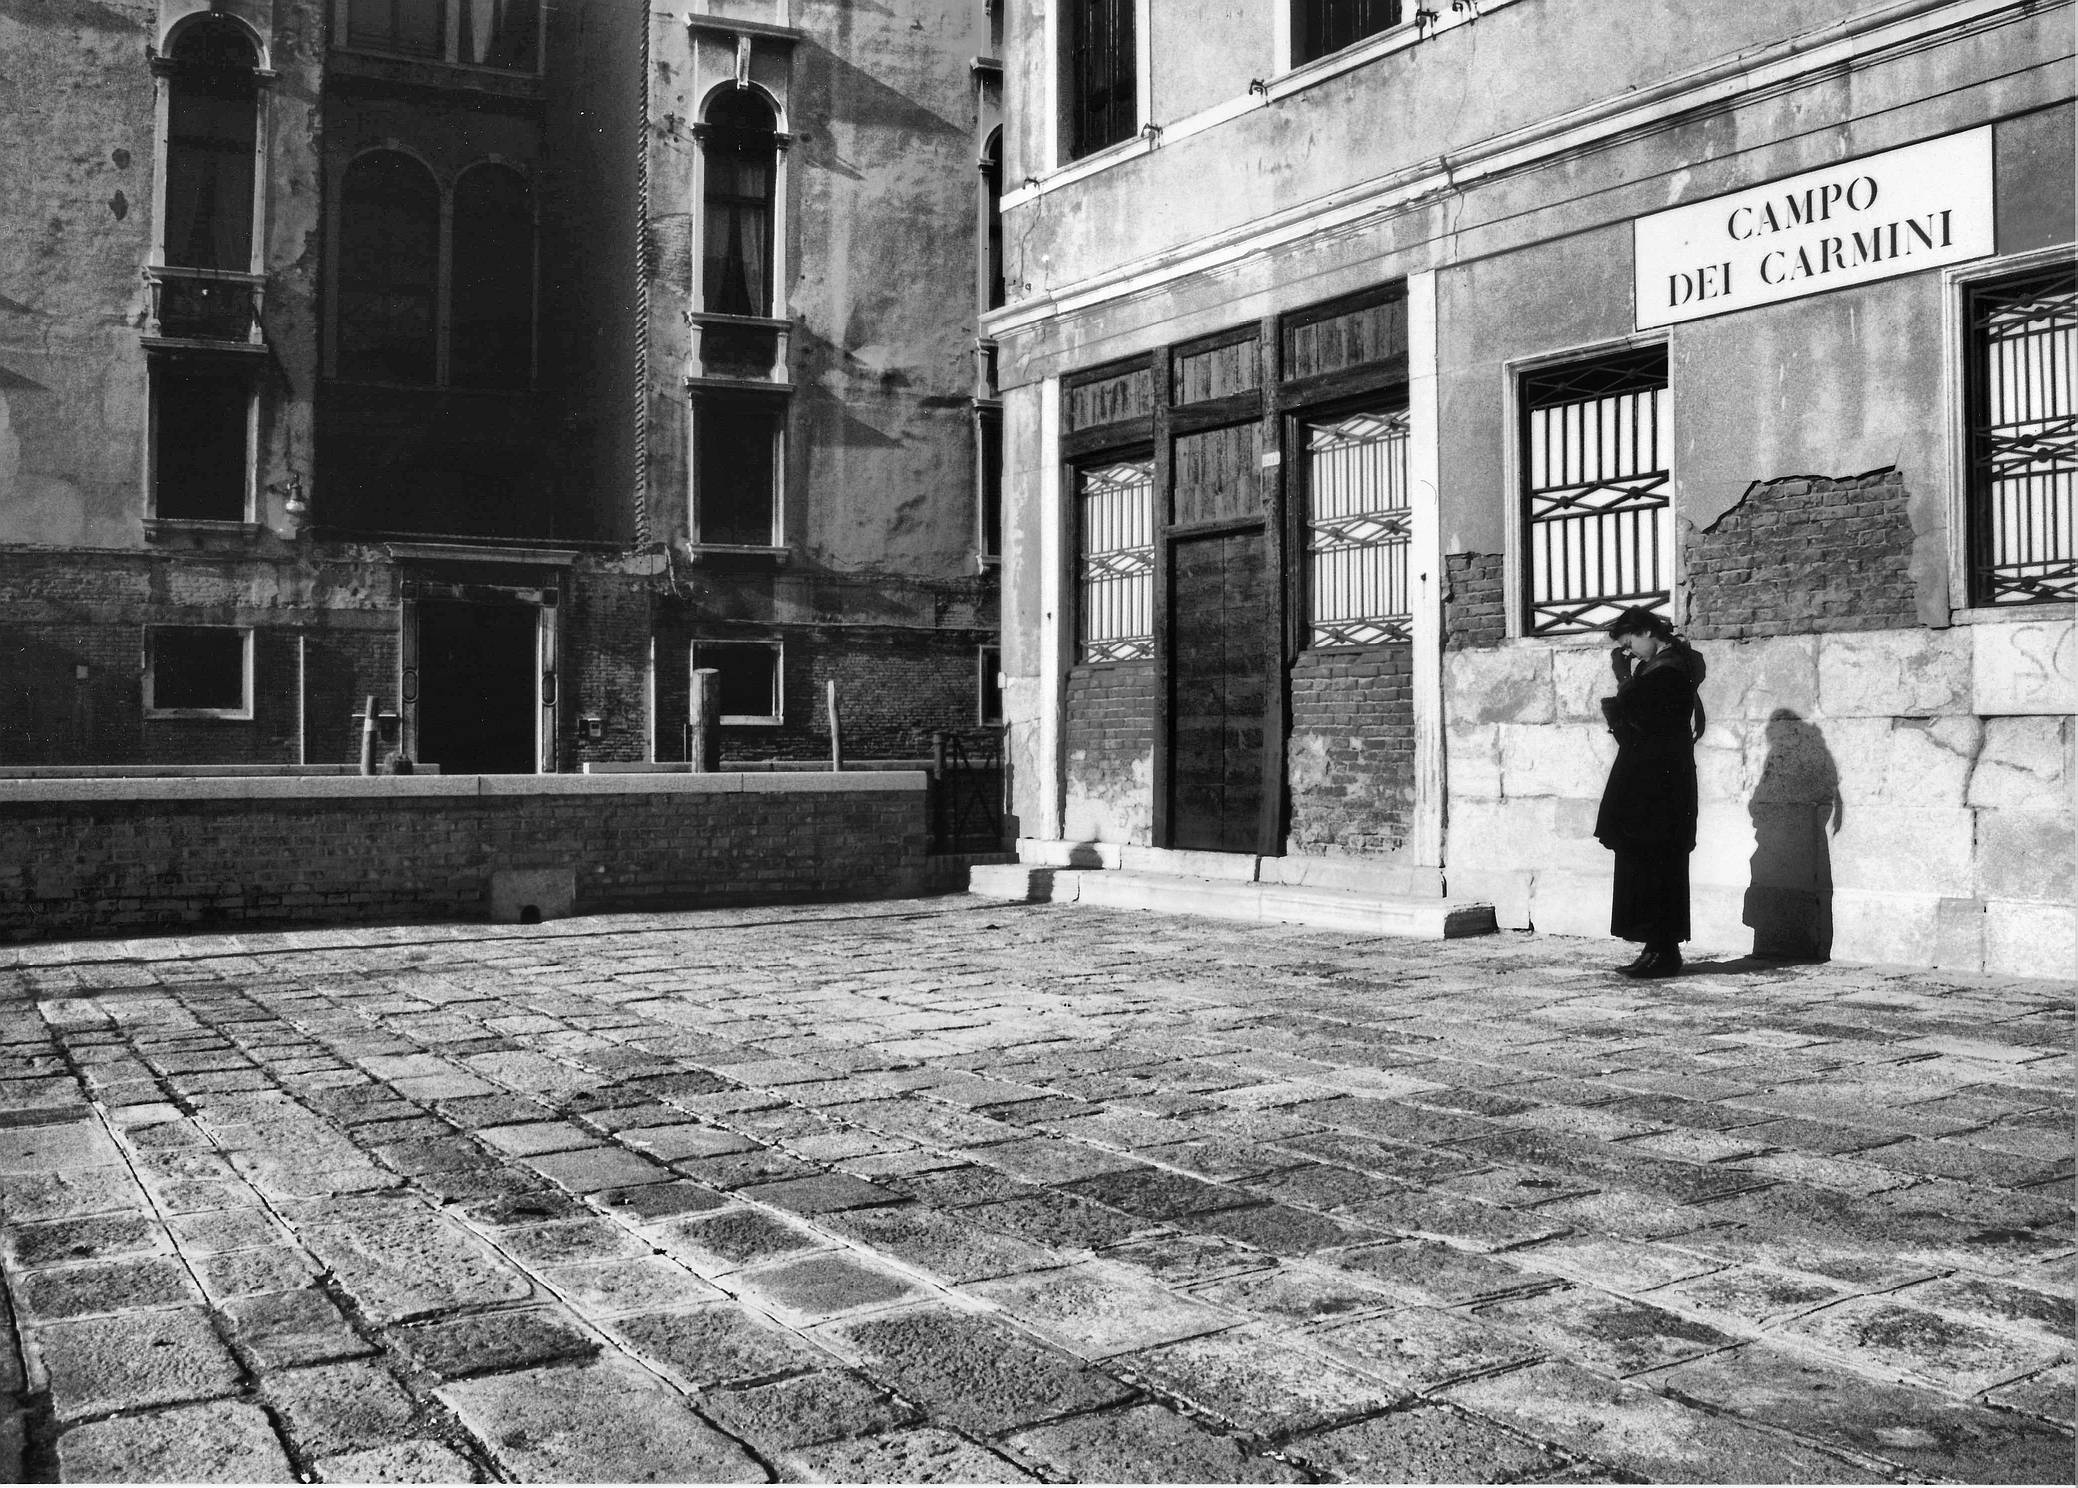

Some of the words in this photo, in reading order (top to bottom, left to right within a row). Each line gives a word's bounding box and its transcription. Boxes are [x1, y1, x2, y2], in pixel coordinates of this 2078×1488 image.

[1727, 175, 1879, 241] CAMPO
[1668, 262, 1733, 307] DEI
[1759, 209, 1953, 285] CARMINI
